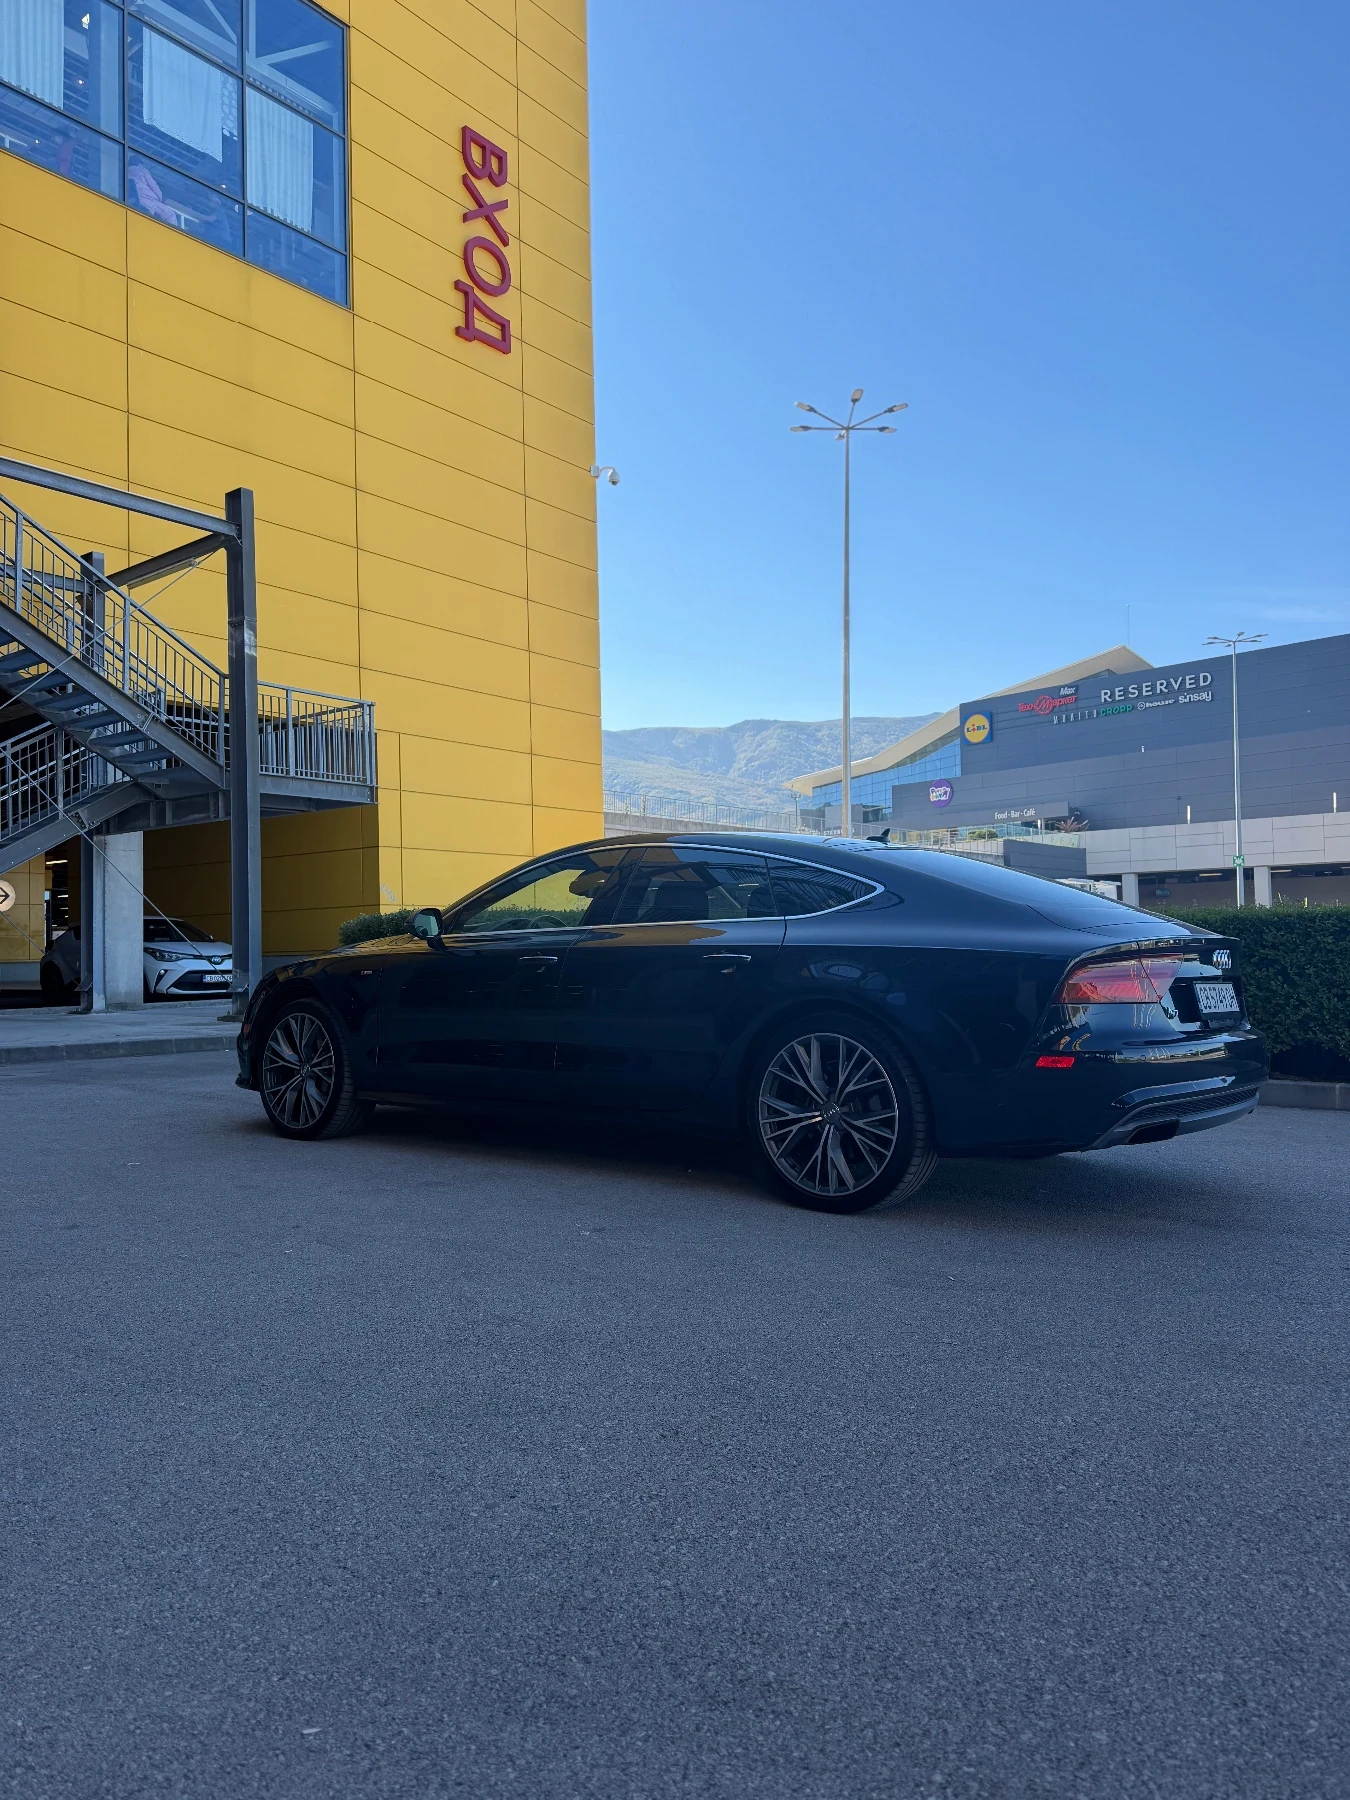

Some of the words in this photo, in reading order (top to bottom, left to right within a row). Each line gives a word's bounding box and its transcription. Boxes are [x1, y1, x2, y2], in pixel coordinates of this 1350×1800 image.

[454, 125, 512, 355] ВХОД
[1101, 672, 1212, 702] RESERVED
[1100, 704, 1133, 716] CROPP
[994, 811, 1008, 820] Food
[1010, 810, 1021, 818] Bar
